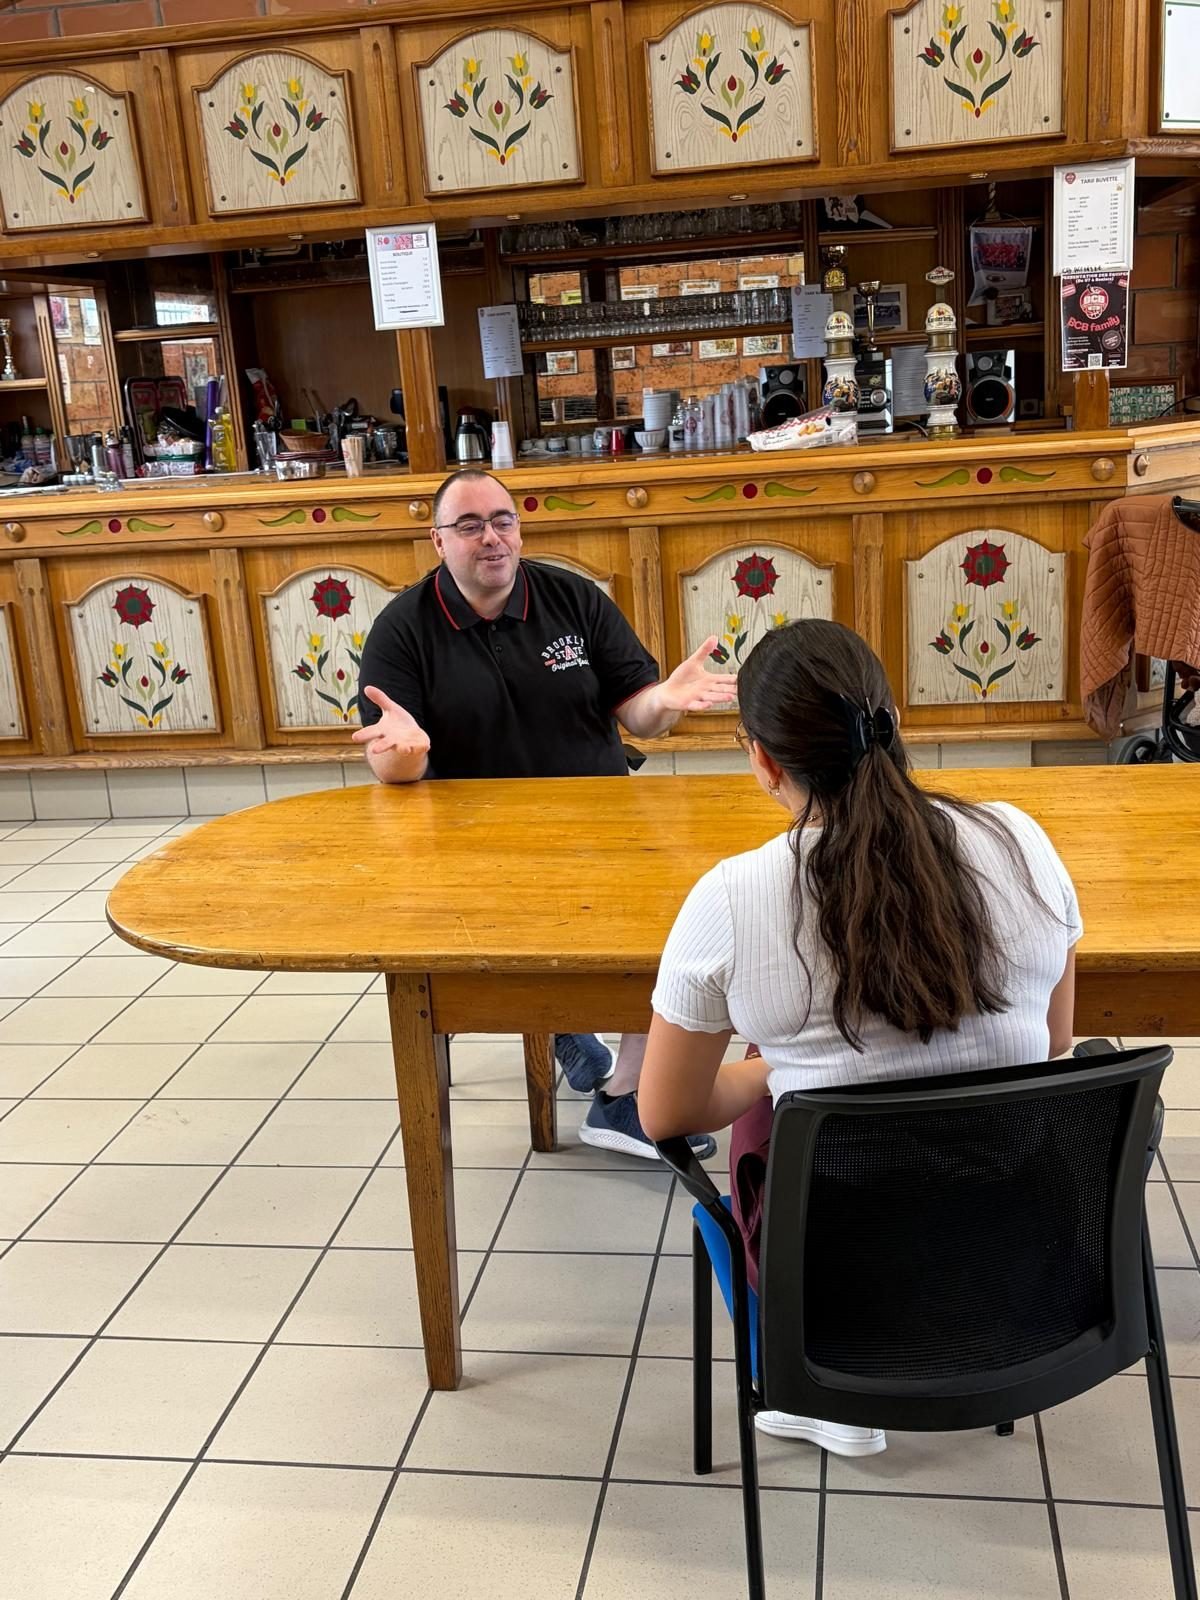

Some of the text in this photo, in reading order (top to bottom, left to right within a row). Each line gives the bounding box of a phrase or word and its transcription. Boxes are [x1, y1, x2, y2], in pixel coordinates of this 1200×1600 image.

[1083, 295, 1105, 304] BCB
[1067, 315, 1120, 331] BCB family
[554, 645, 584, 661] STATE
